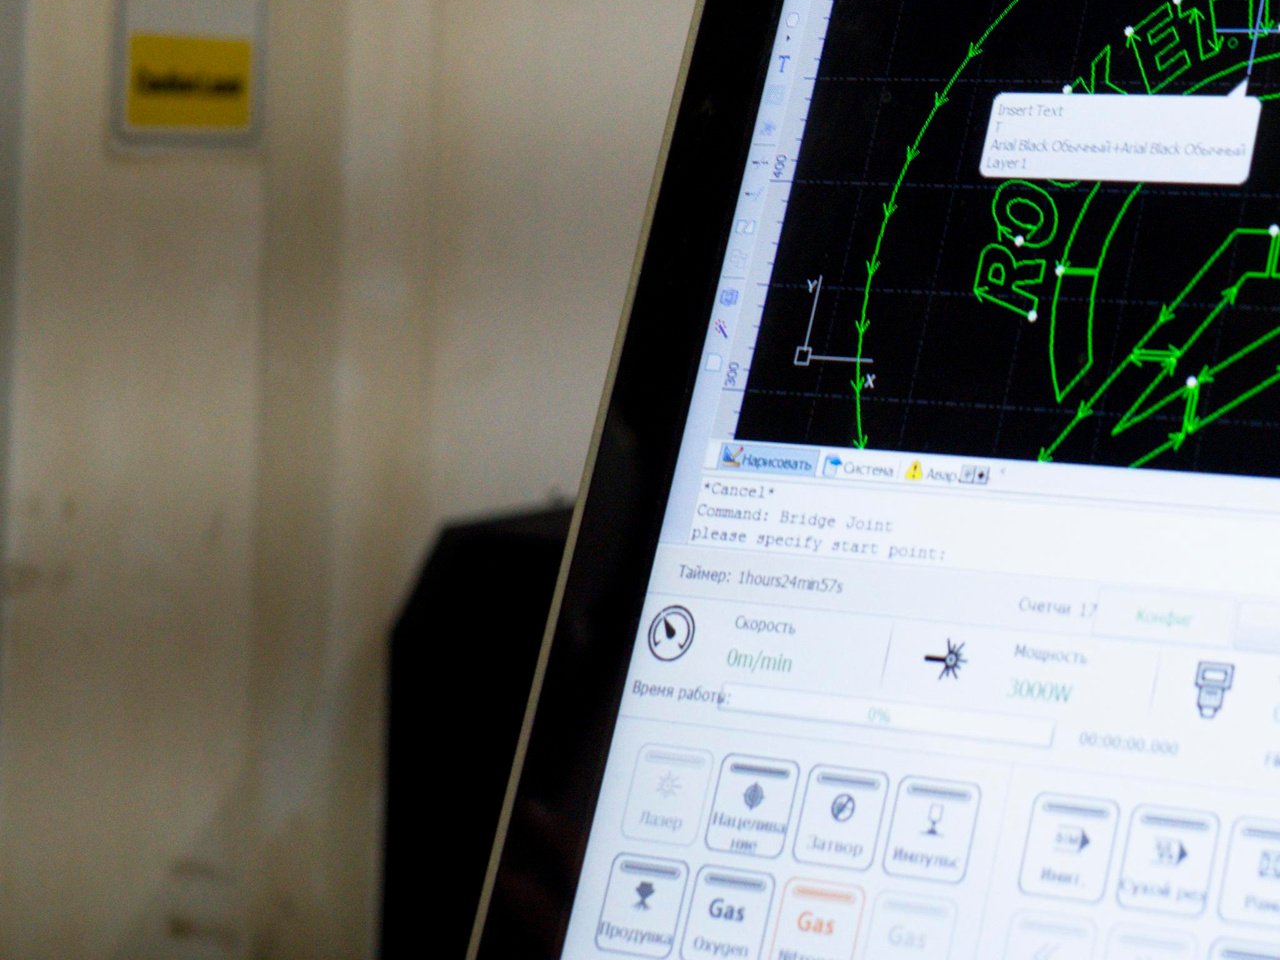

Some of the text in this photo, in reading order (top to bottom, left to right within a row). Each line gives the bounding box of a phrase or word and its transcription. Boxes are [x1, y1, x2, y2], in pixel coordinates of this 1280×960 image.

[997, 104, 1064, 118] Insert Text
[989, 138, 1017, 153] Arial
[1018, 139, 1049, 153] Black
[1149, 141, 1182, 156] Black
[773, 154, 788, 179] 400
[725, 361, 740, 388] 300
[741, 453, 813, 473] Нарисовать
[843, 461, 894, 478] Система
[697, 503, 894, 534] Command: Bridge Joint
[691, 526, 946, 561] please specify start point:
[679, 563, 732, 585] Таймер:
[735, 614, 797, 636] Скорость
[726, 647, 794, 675] 0m/min
[1013, 643, 1088, 666] Мощность
[632, 678, 674, 698] Время
[1005, 676, 1074, 704] 3000W
[638, 809, 684, 832] Лазер
[712, 810, 788, 836] Нацелива
[806, 833, 864, 858] Затвор
[708, 897, 746, 923] Gas
[599, 920, 674, 946] Продувка
[797, 911, 836, 936] Gas
[693, 935, 750, 959] Oxygen
[887, 924, 928, 951] Gas
